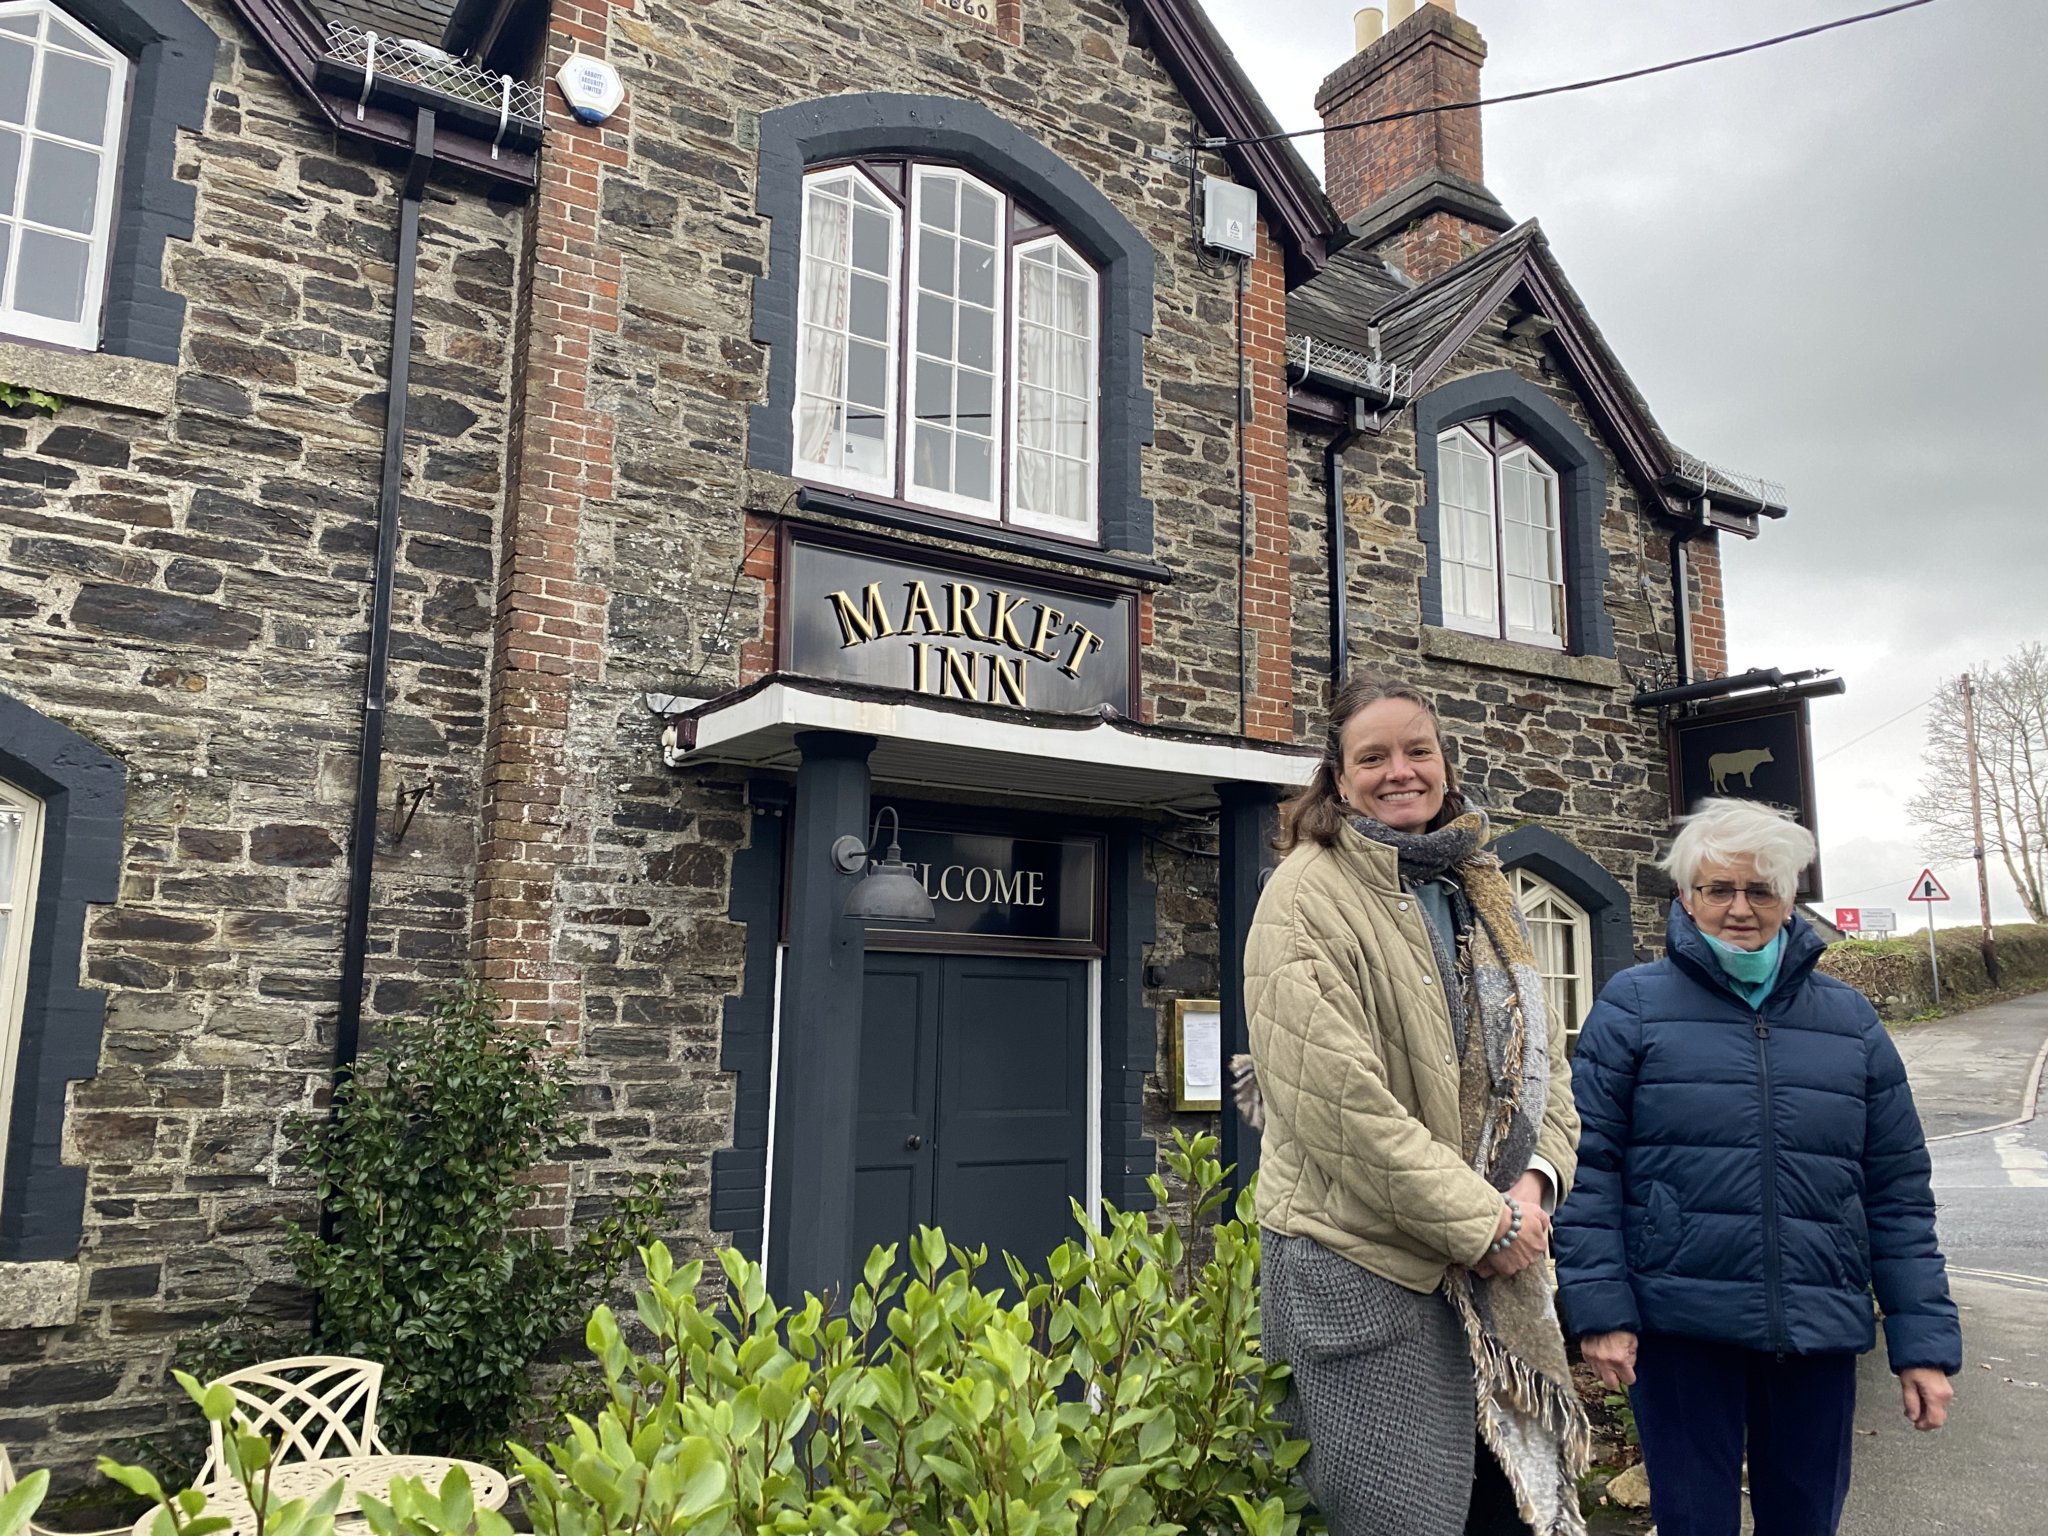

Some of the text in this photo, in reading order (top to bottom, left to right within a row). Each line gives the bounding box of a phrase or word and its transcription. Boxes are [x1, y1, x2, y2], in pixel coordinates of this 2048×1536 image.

[582, 77, 603, 88] SECURITY
[583, 84, 601, 95] LIMITED
[827, 580, 1105, 678] MARKET
[910, 641, 1029, 707] INN
[870, 859, 1045, 906] LCOME
